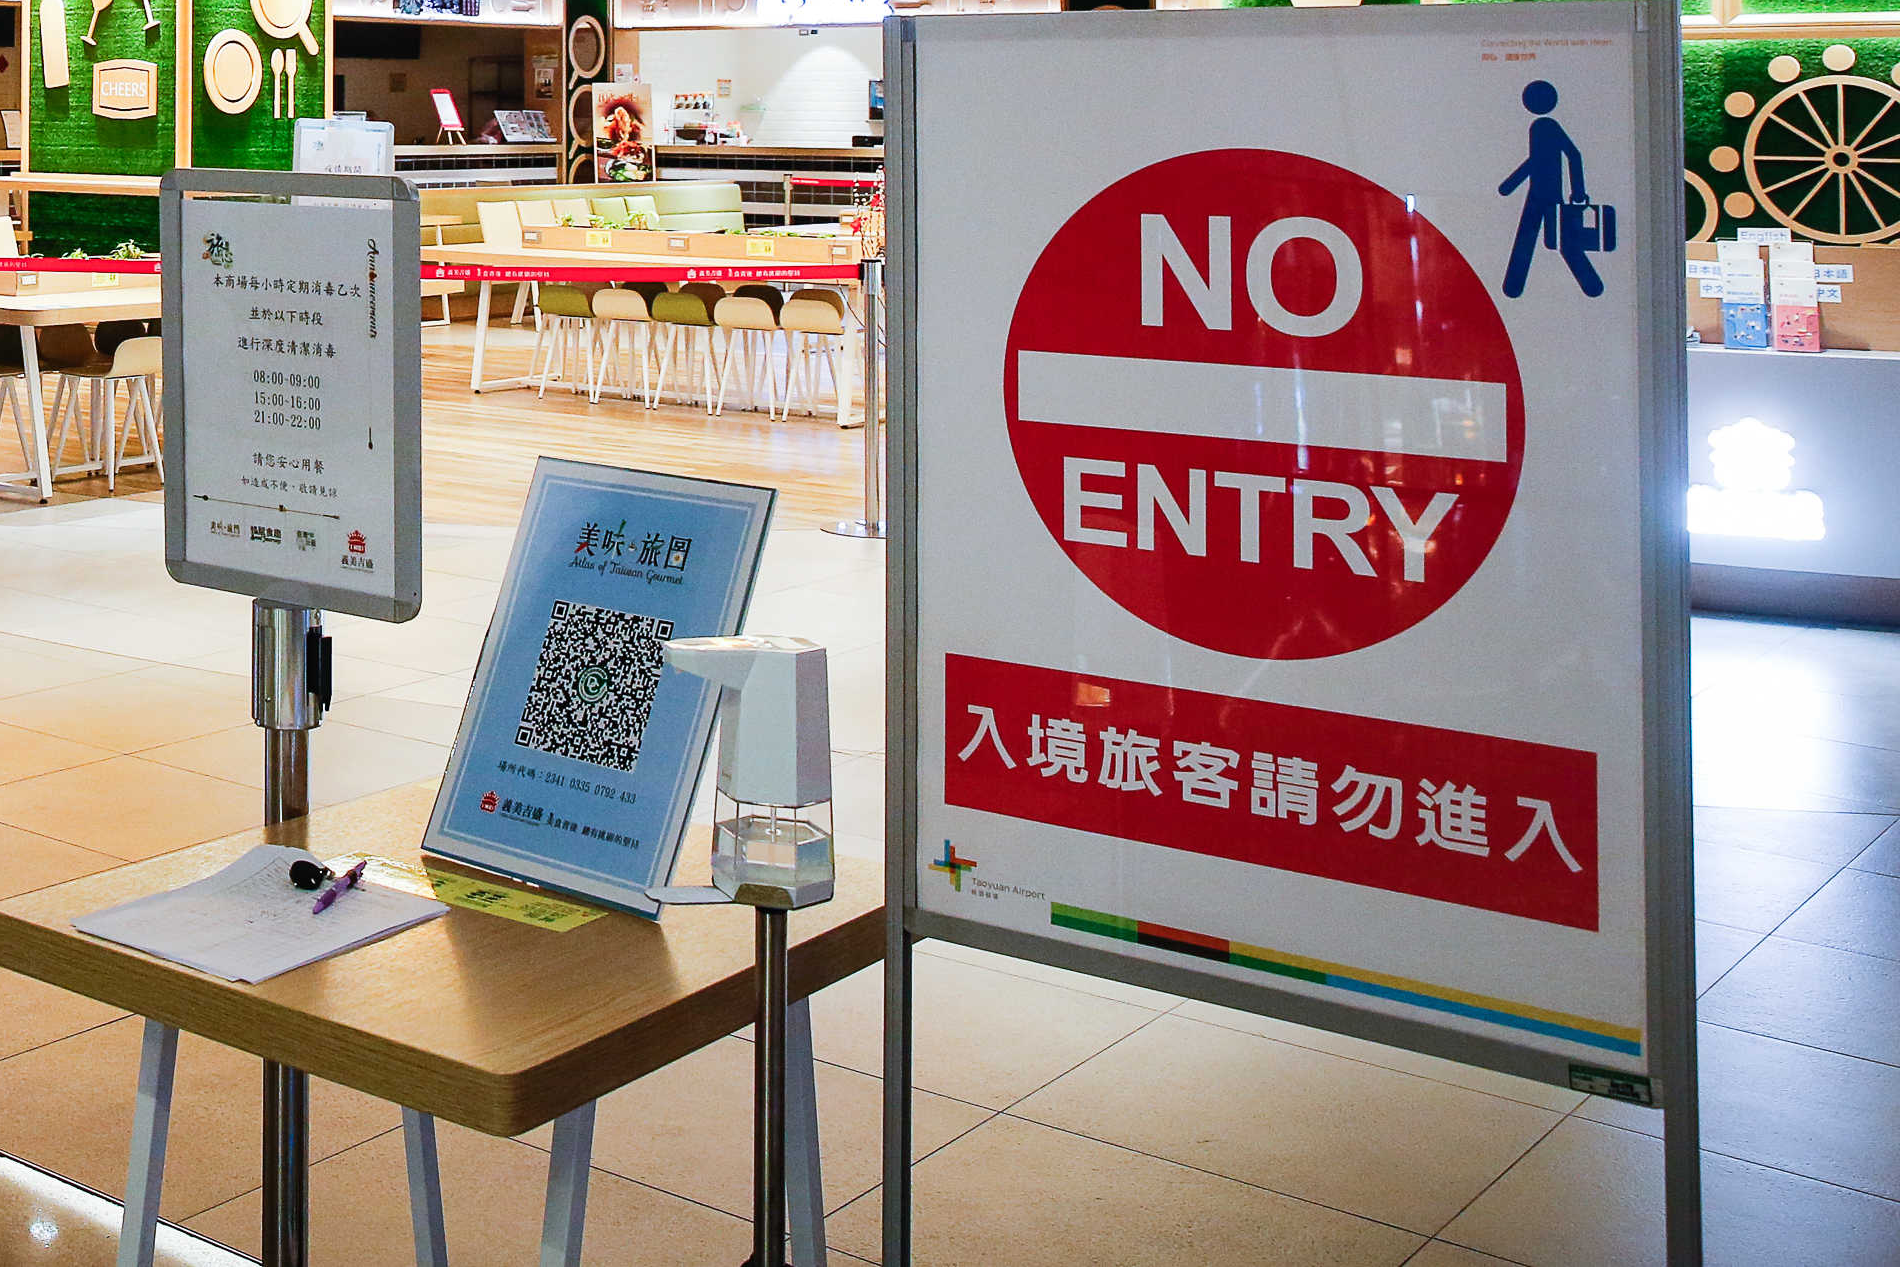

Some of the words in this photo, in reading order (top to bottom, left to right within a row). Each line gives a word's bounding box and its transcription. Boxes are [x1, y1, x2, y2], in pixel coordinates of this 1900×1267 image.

[101, 81, 147, 97] CHEERS
[1740, 231, 1788, 243] English
[213, 273, 362, 298] 本商場每小時定期消毒乙次
[1139, 212, 1365, 339] NO
[1702, 283, 1724, 294] 中文
[249, 306, 324, 326] 並於以下時段
[237, 335, 337, 359] 進行深度清潔消毒
[253, 451, 325, 474] 請您安心用餐
[1063, 455, 1462, 585] ENTRY
[568, 555, 595, 570] Atlas
[598, 560, 608, 577] of
[610, 561, 643, 579] Taiwan
[646, 569, 684, 585] Gourmet
[544, 771, 565, 787] 2341
[569, 778, 591, 793] 0335
[594, 784, 616, 799] 0792
[619, 790, 637, 804] 433
[957, 702, 1583, 874] 入境旅客請勿進入
[972, 877, 1010, 893] Taoyuan
[1012, 885, 1046, 900] Airport
